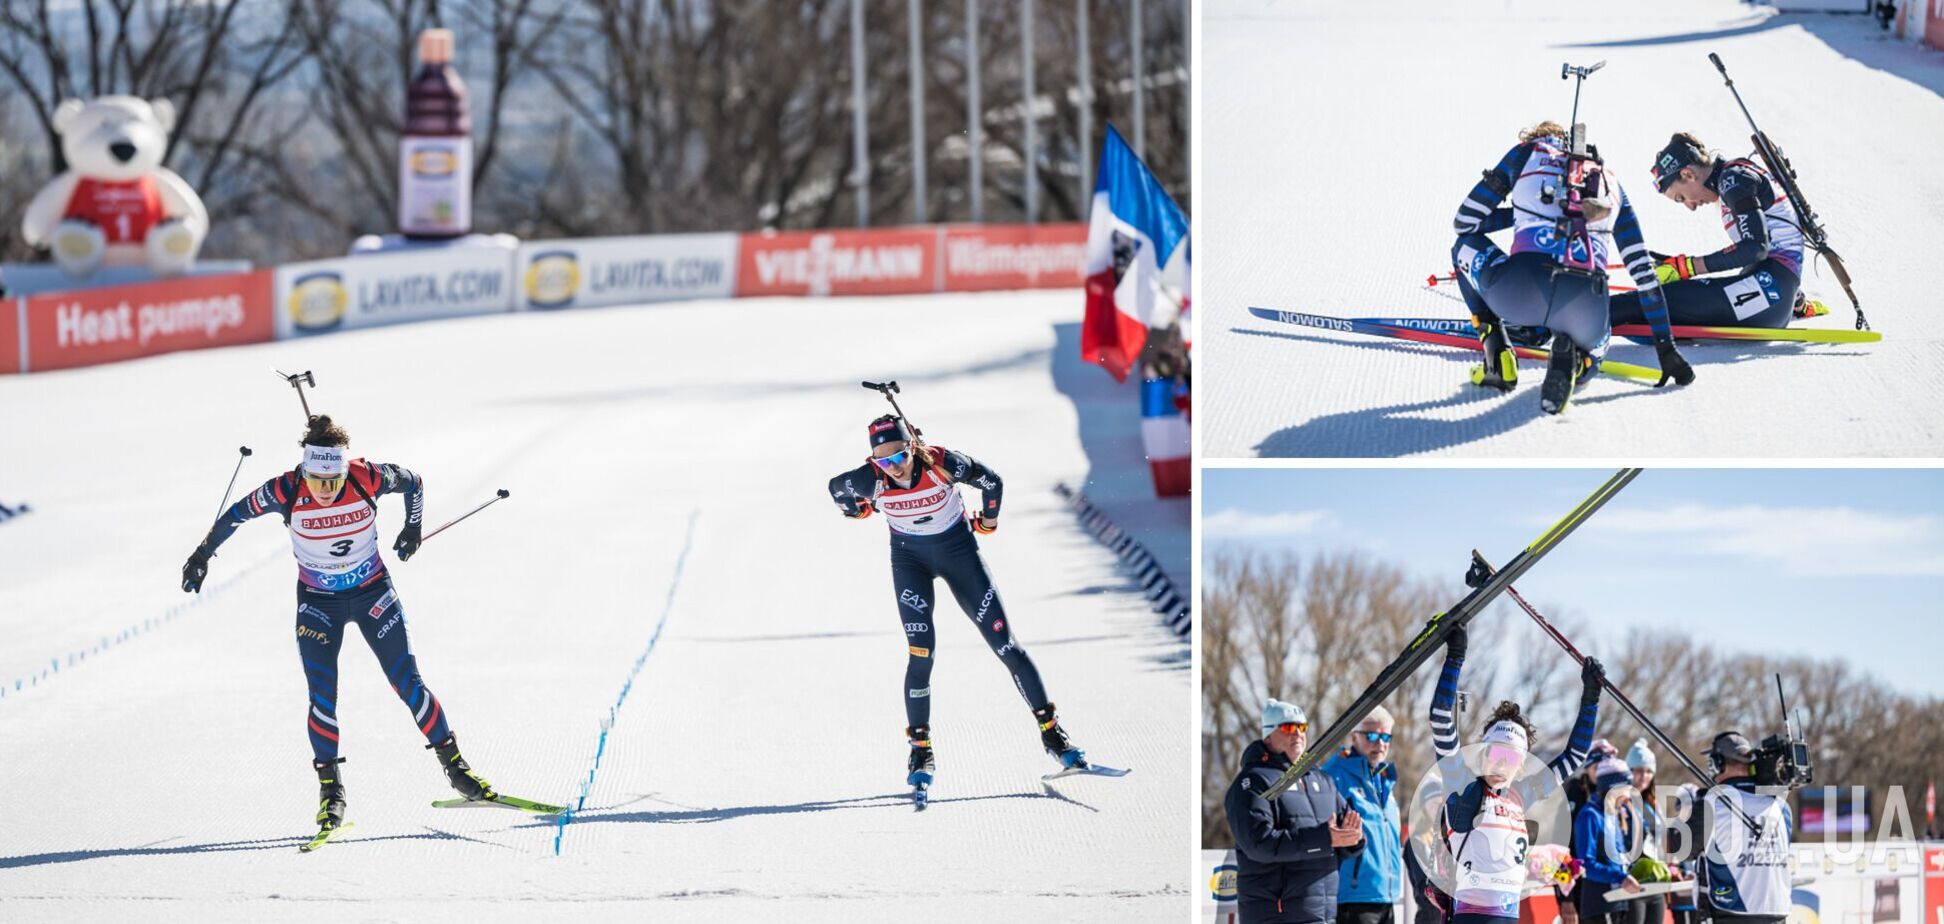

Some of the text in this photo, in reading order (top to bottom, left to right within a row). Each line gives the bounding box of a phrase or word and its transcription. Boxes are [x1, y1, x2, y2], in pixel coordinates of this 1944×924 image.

[358, 269, 504, 314] LAVITA.COM
[1733, 290, 1761, 308] 4
[57, 302, 133, 347] Heat
[137, 294, 245, 346] pumps
[1278, 310, 1353, 332] SALOMON
[884, 489, 947, 510] BAUHAUS
[302, 508, 371, 530] BAUHAUS
[329, 539, 354, 557] 3
[900, 588, 929, 610] EA7
[1514, 837, 1528, 866] 3
[1463, 860, 1473, 876] 3
